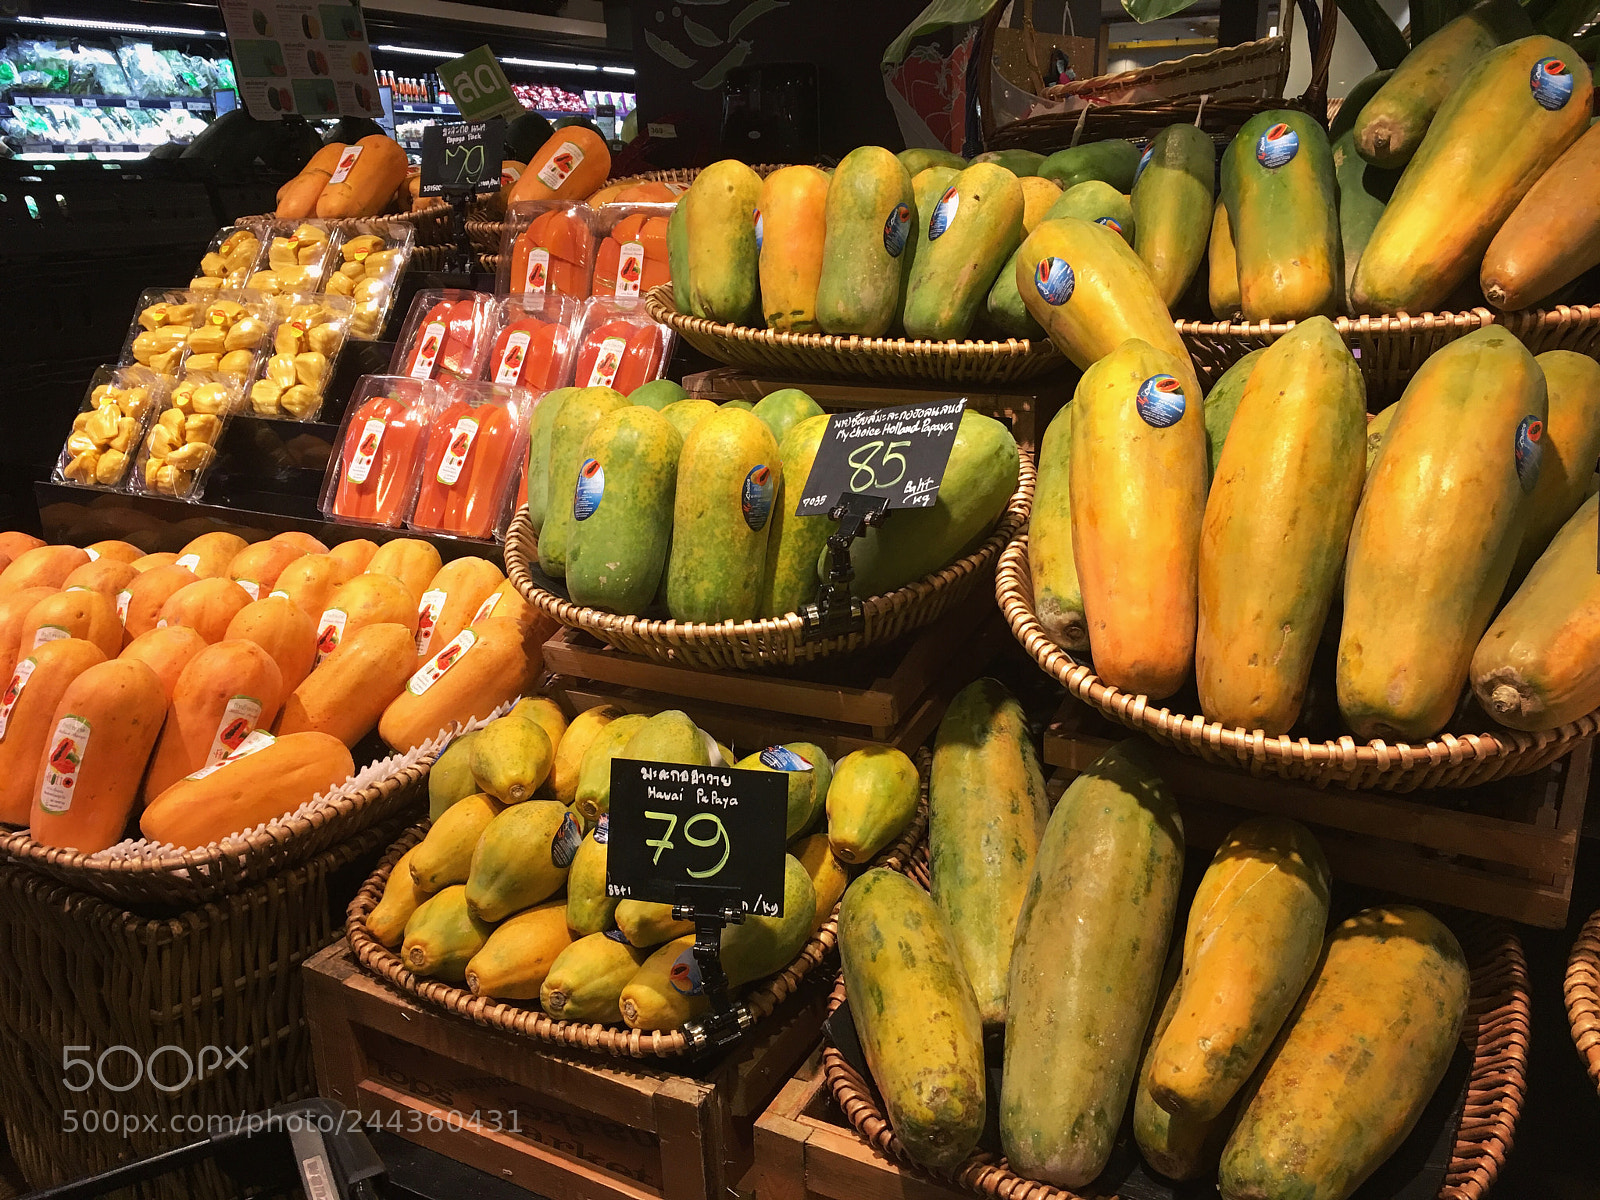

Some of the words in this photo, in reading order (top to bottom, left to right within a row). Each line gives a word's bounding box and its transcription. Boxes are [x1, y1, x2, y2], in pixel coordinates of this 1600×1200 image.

[453, 64, 501, 103] สด
[881, 419, 920, 436] Holland
[921, 417, 954, 438] Papaya
[848, 440, 912, 493] 85
[802, 494, 827, 508] 7035
[644, 809, 731, 880] 79
